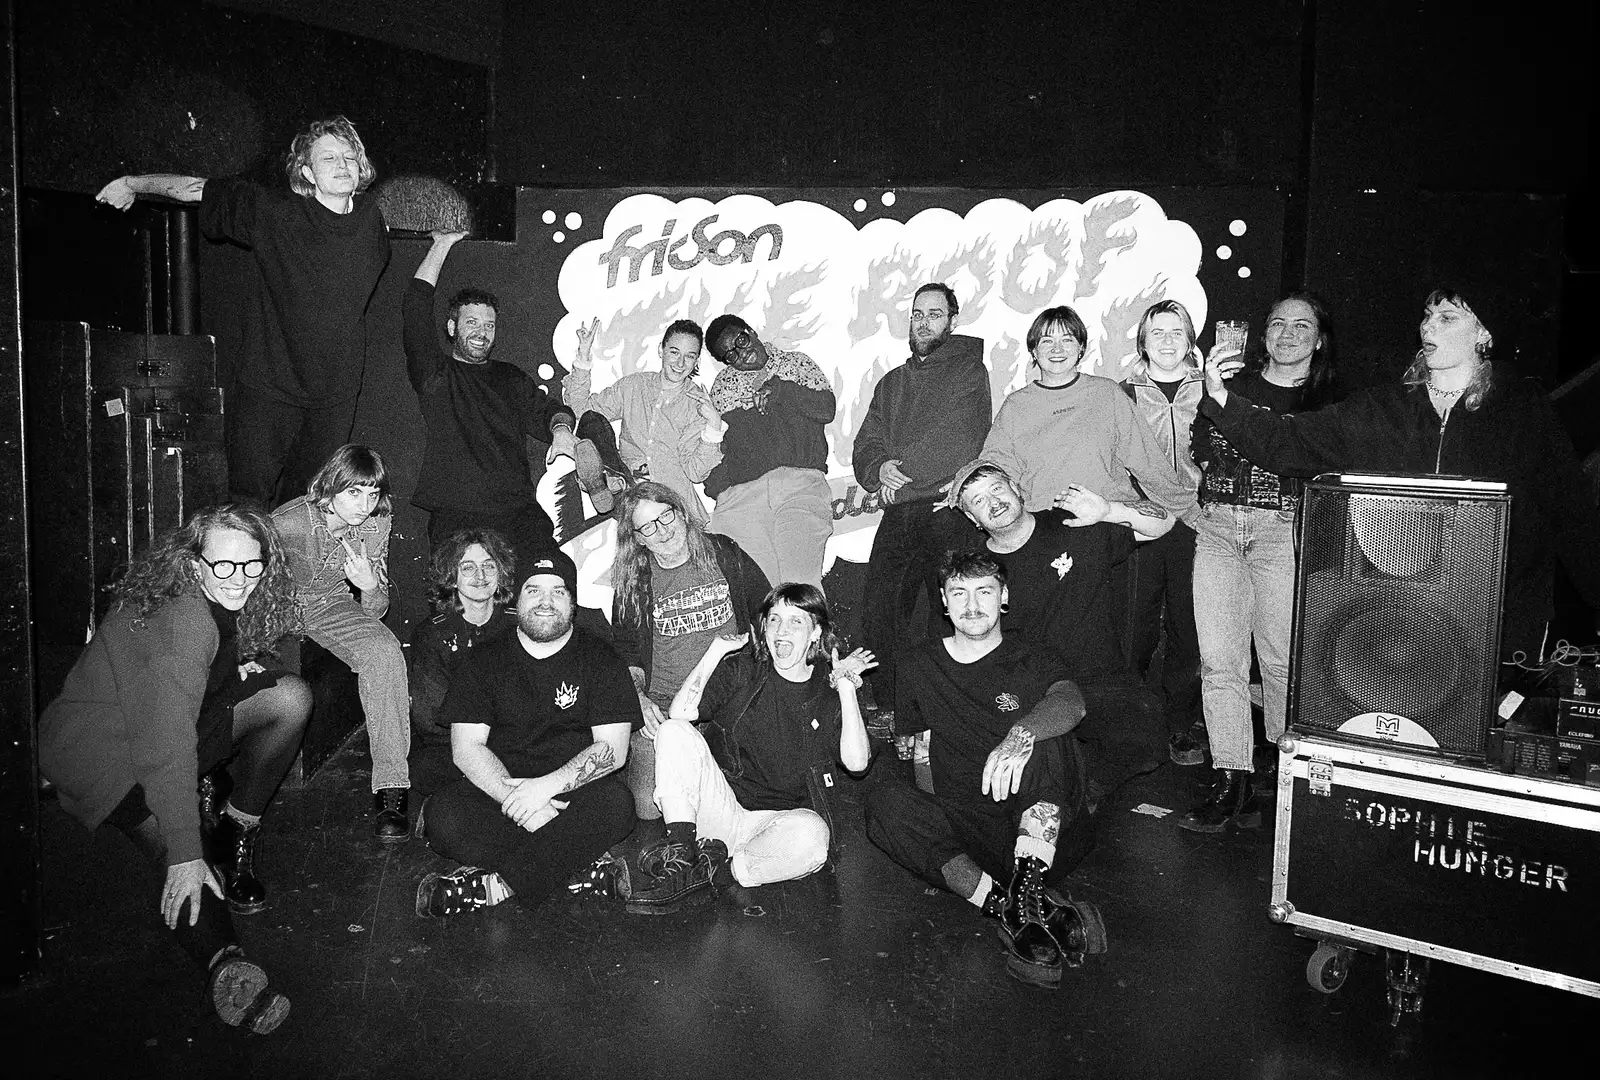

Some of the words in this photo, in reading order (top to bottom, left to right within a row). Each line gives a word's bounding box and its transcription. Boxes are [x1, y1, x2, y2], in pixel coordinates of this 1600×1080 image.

[847, 196, 1140, 348] ROOF
[1344, 798, 1488, 847] SOPHIE
[1414, 839, 1568, 892] HUNGER
